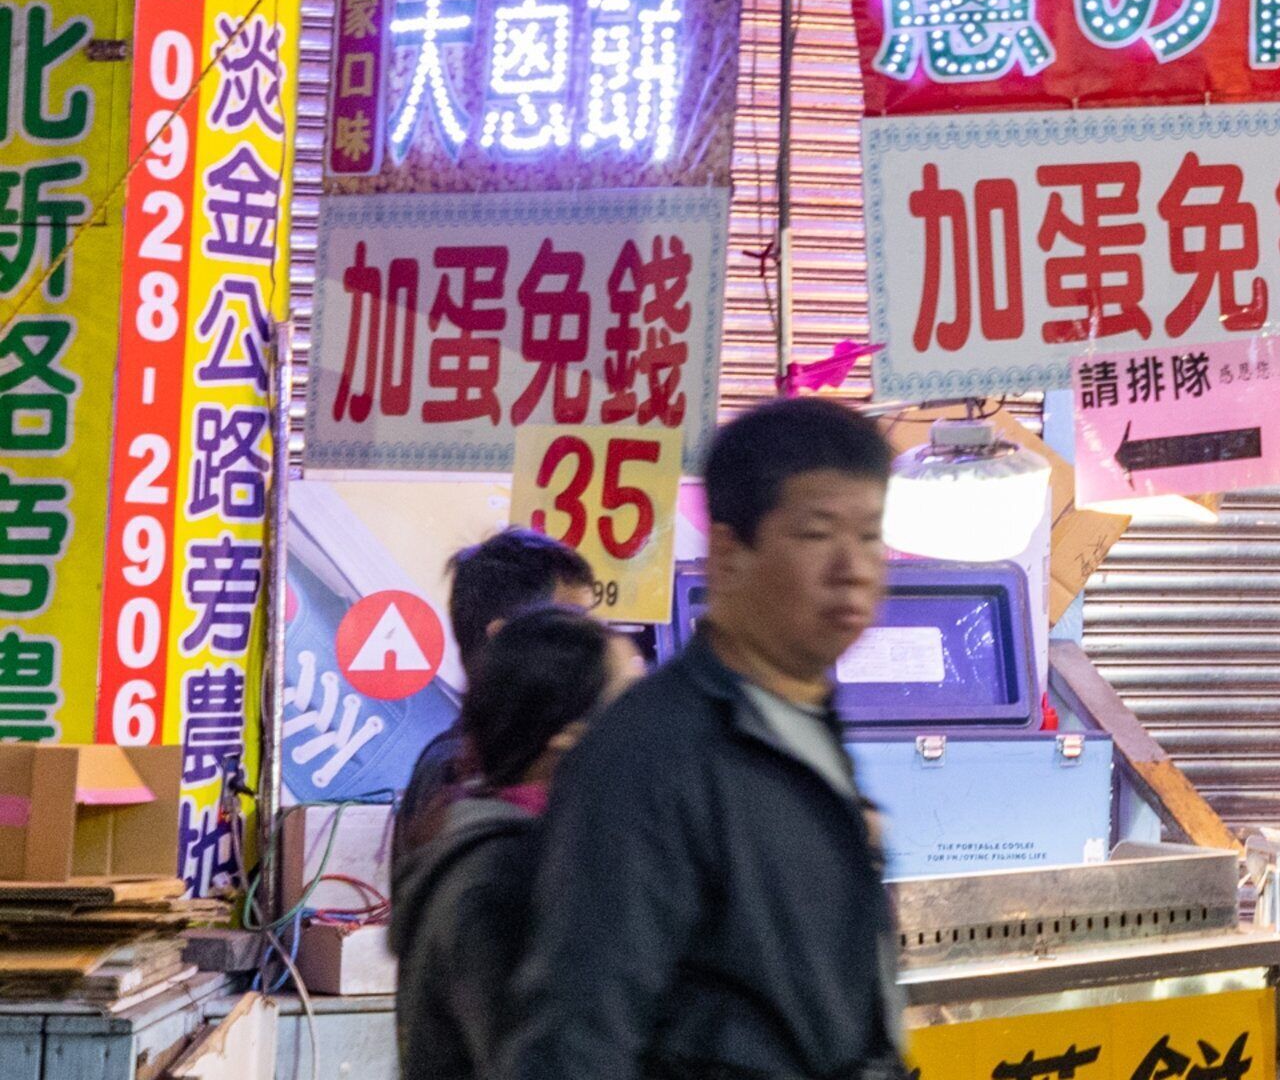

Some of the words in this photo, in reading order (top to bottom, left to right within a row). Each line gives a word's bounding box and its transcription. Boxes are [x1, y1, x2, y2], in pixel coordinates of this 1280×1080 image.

[333, 235, 693, 428] 加蛋免錢
[1079, 352, 1212, 410] 請排隊
[530, 435, 661, 560] 35
